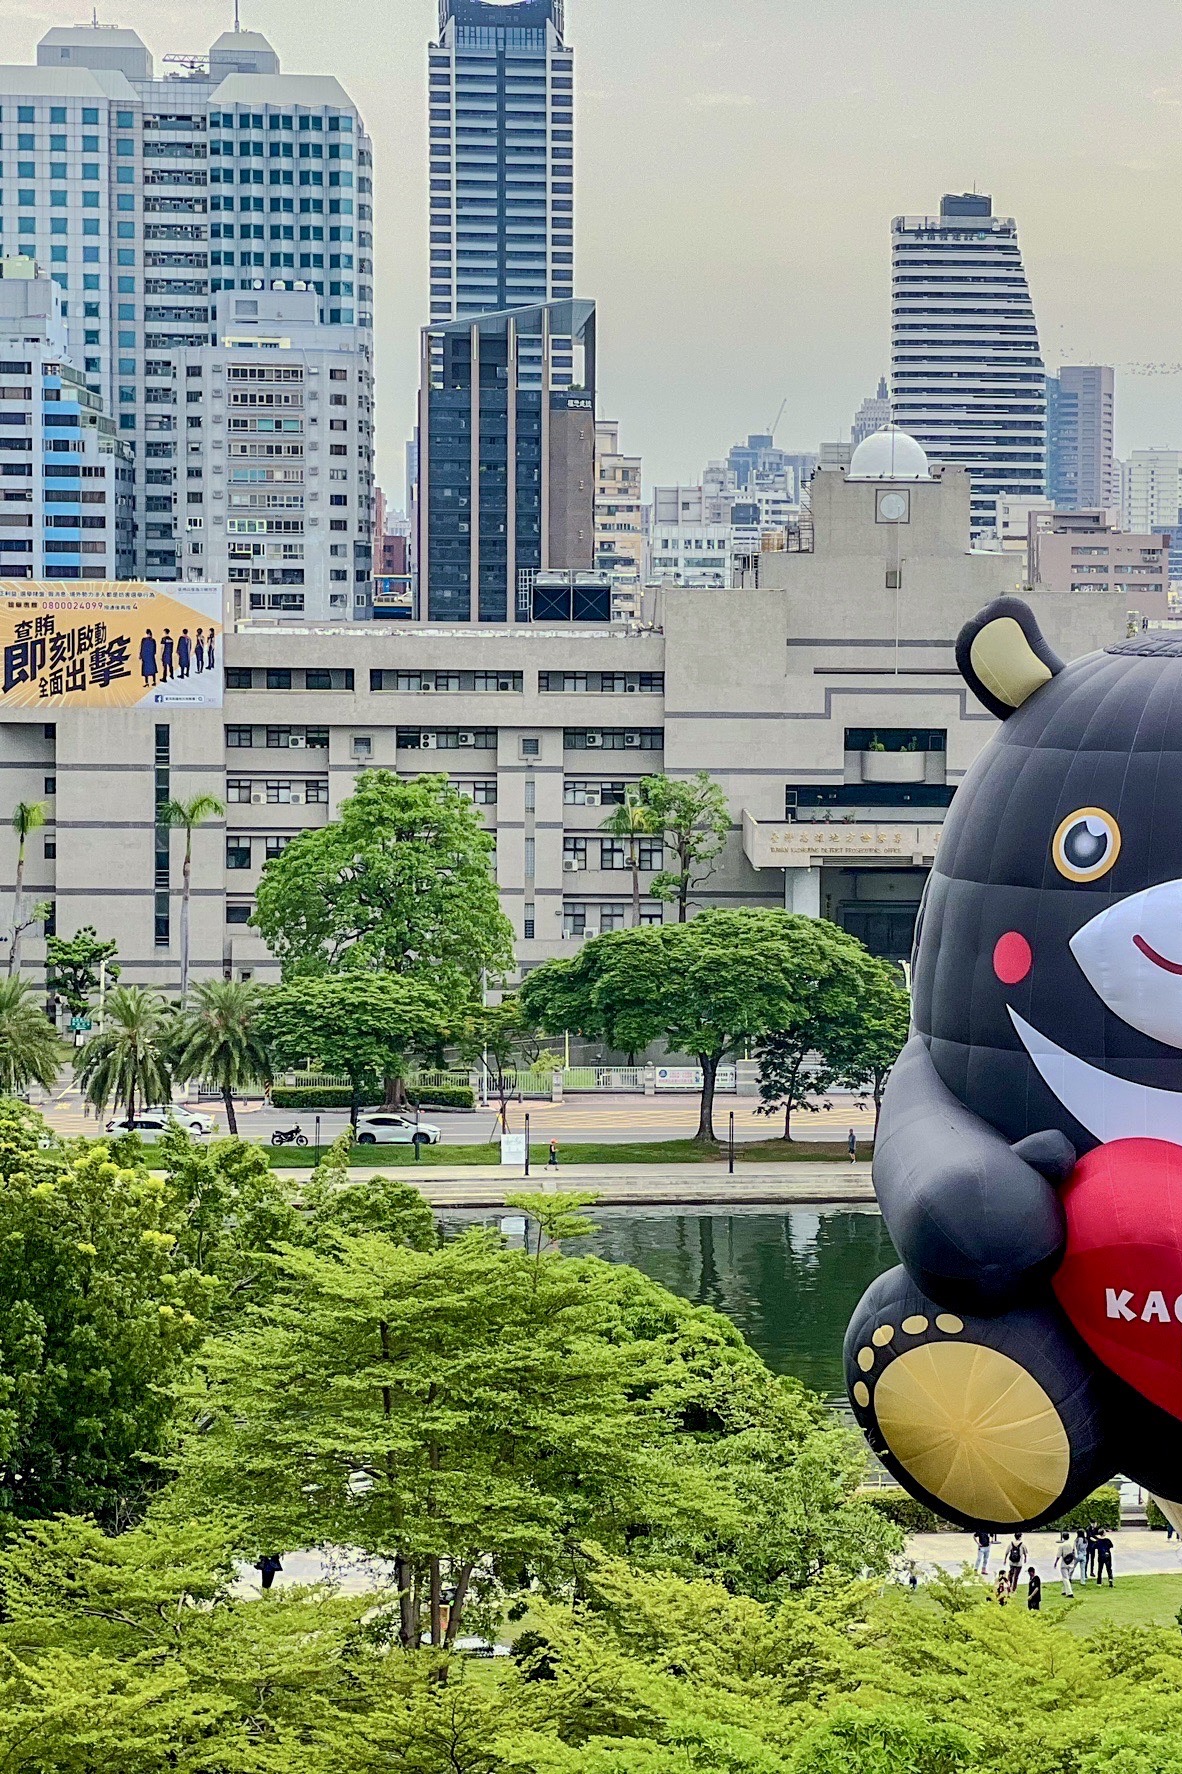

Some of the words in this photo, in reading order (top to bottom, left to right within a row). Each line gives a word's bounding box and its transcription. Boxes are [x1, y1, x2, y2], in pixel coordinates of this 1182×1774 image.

[14, 614, 55, 643] 查賄
[42, 601, 103, 610] 0800024099
[132, 602, 138, 610] 4
[2, 621, 107, 694] 即刻啟動
[38, 634, 131, 698] 全面出擊
